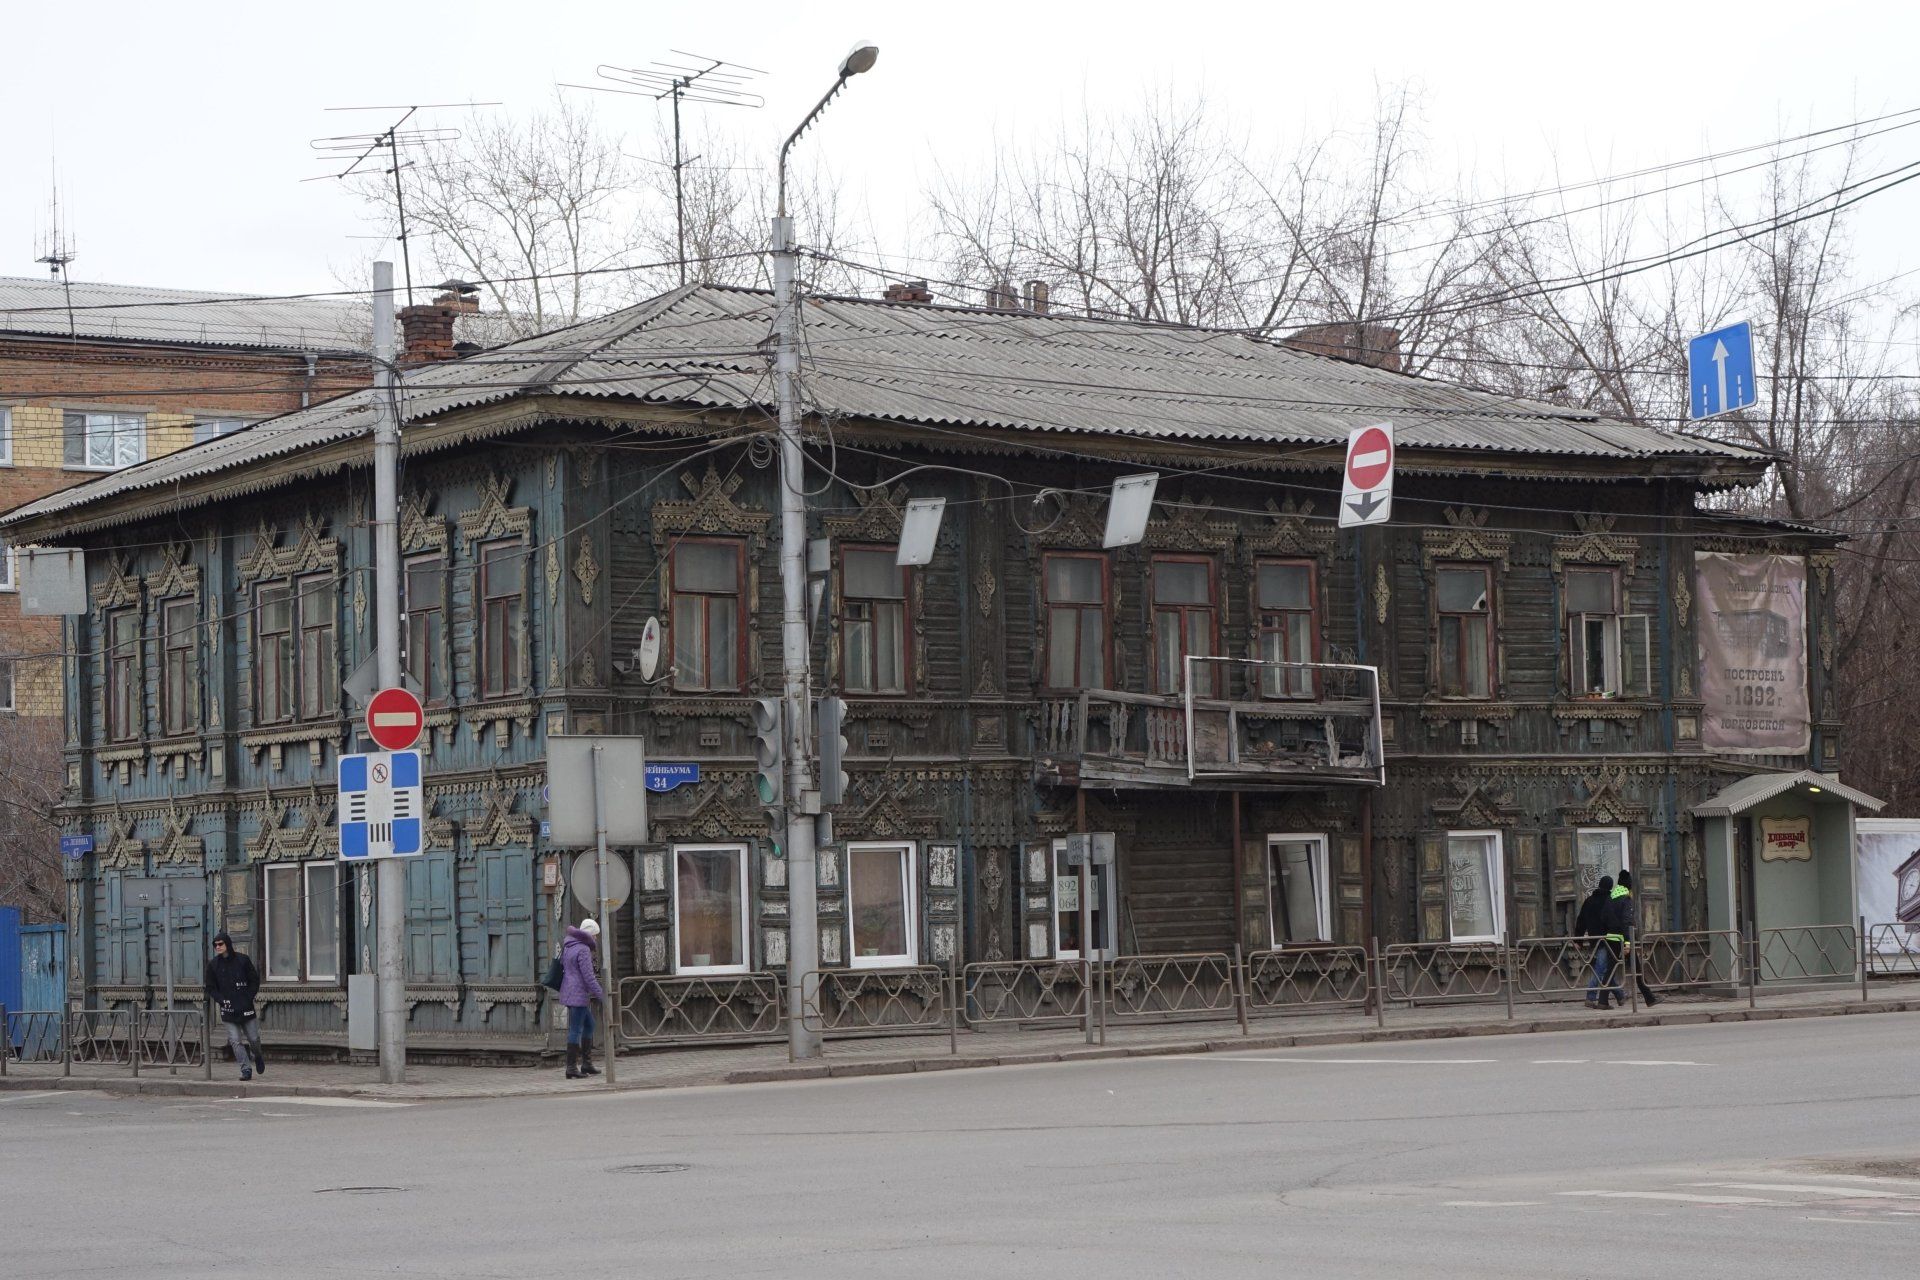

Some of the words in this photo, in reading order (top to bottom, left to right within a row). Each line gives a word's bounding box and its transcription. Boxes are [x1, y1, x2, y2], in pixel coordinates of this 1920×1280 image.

[1724, 668, 1785, 682] ПОСТРОЕНЪ
[1734, 685, 1776, 707] 1892
[654, 776, 668, 788] 34
